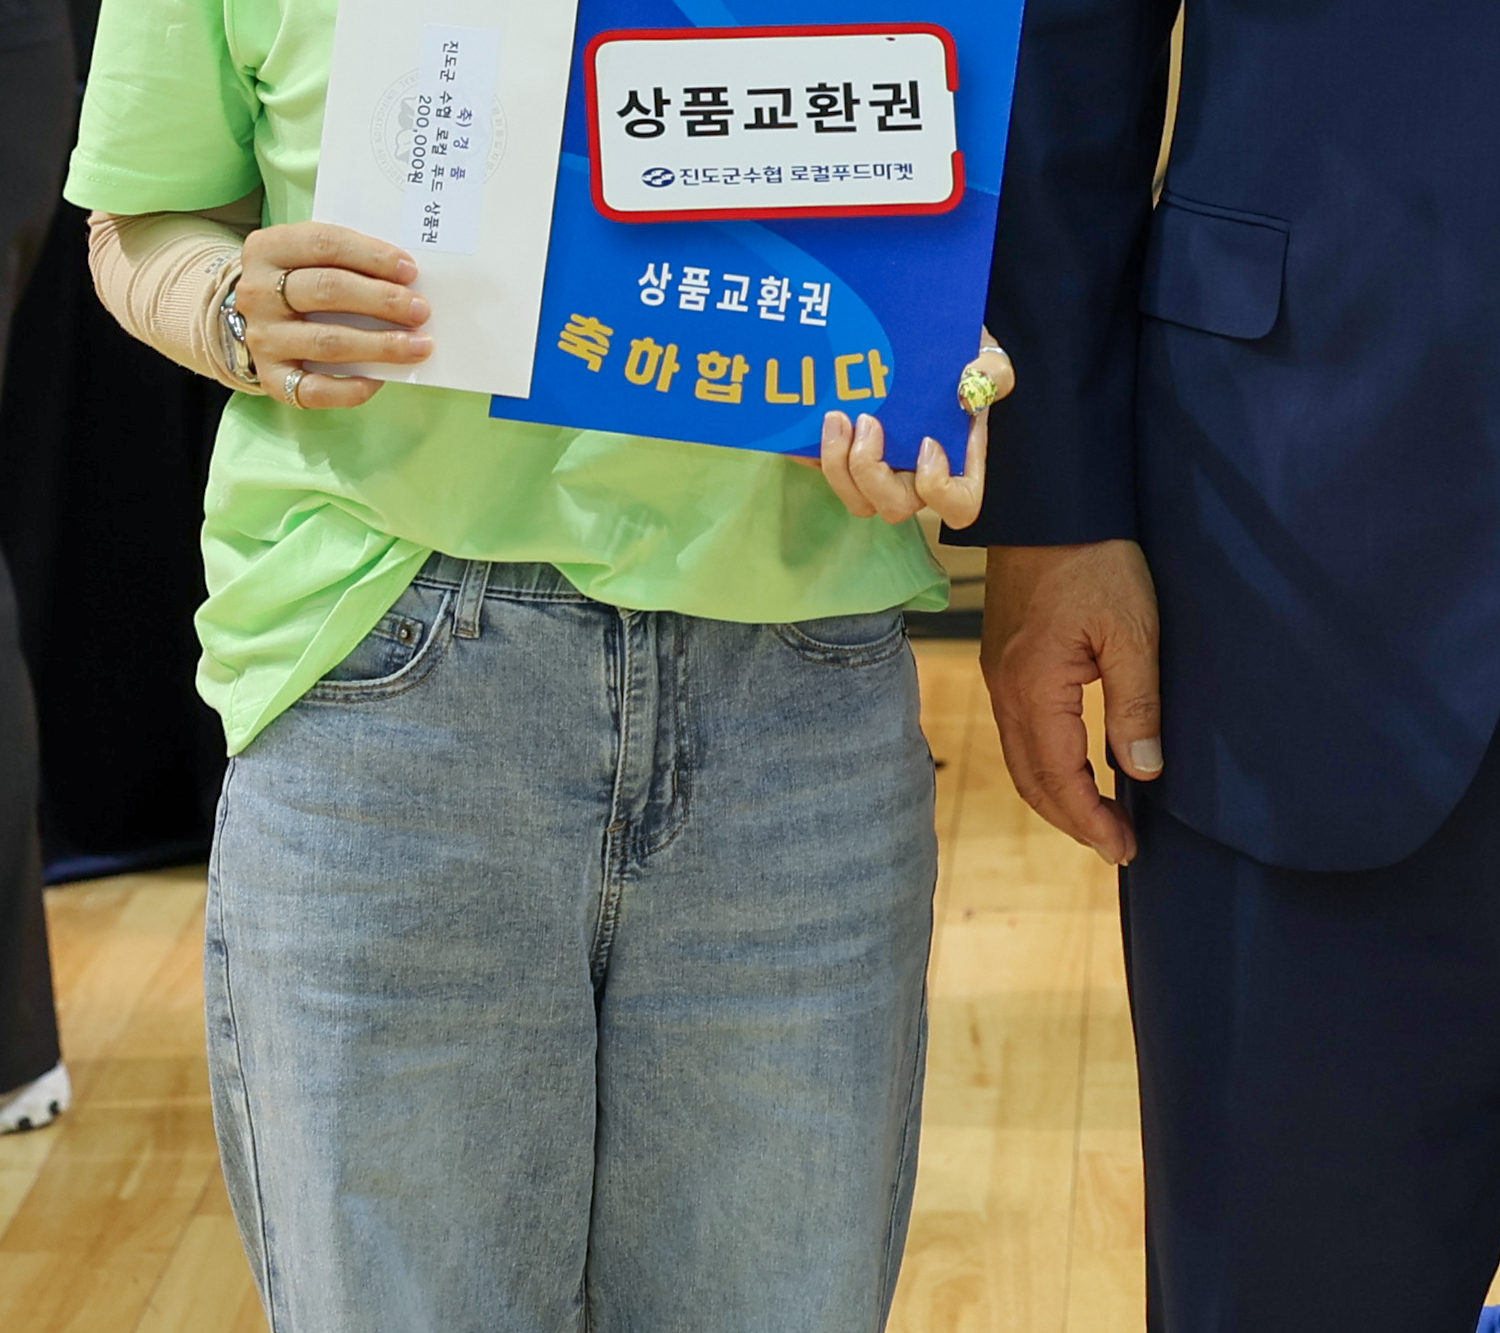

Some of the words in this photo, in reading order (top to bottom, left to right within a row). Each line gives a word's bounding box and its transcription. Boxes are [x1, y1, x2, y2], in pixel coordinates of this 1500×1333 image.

[439, 41, 459, 83] 진도군
[435, 90, 453, 119] 수협
[616, 80, 923, 139] 상품교환권
[407, 94, 432, 184] 200,000원
[431, 127, 449, 156] 로컬
[431, 164, 445, 192] 푸드
[679, 165, 783, 186] 진도군수협
[790, 162, 915, 184] 로컬푸드마켓
[421, 201, 441, 244] 상품권
[638, 262, 831, 327] 상품교환권
[557, 312, 890, 406] 축하합니다
